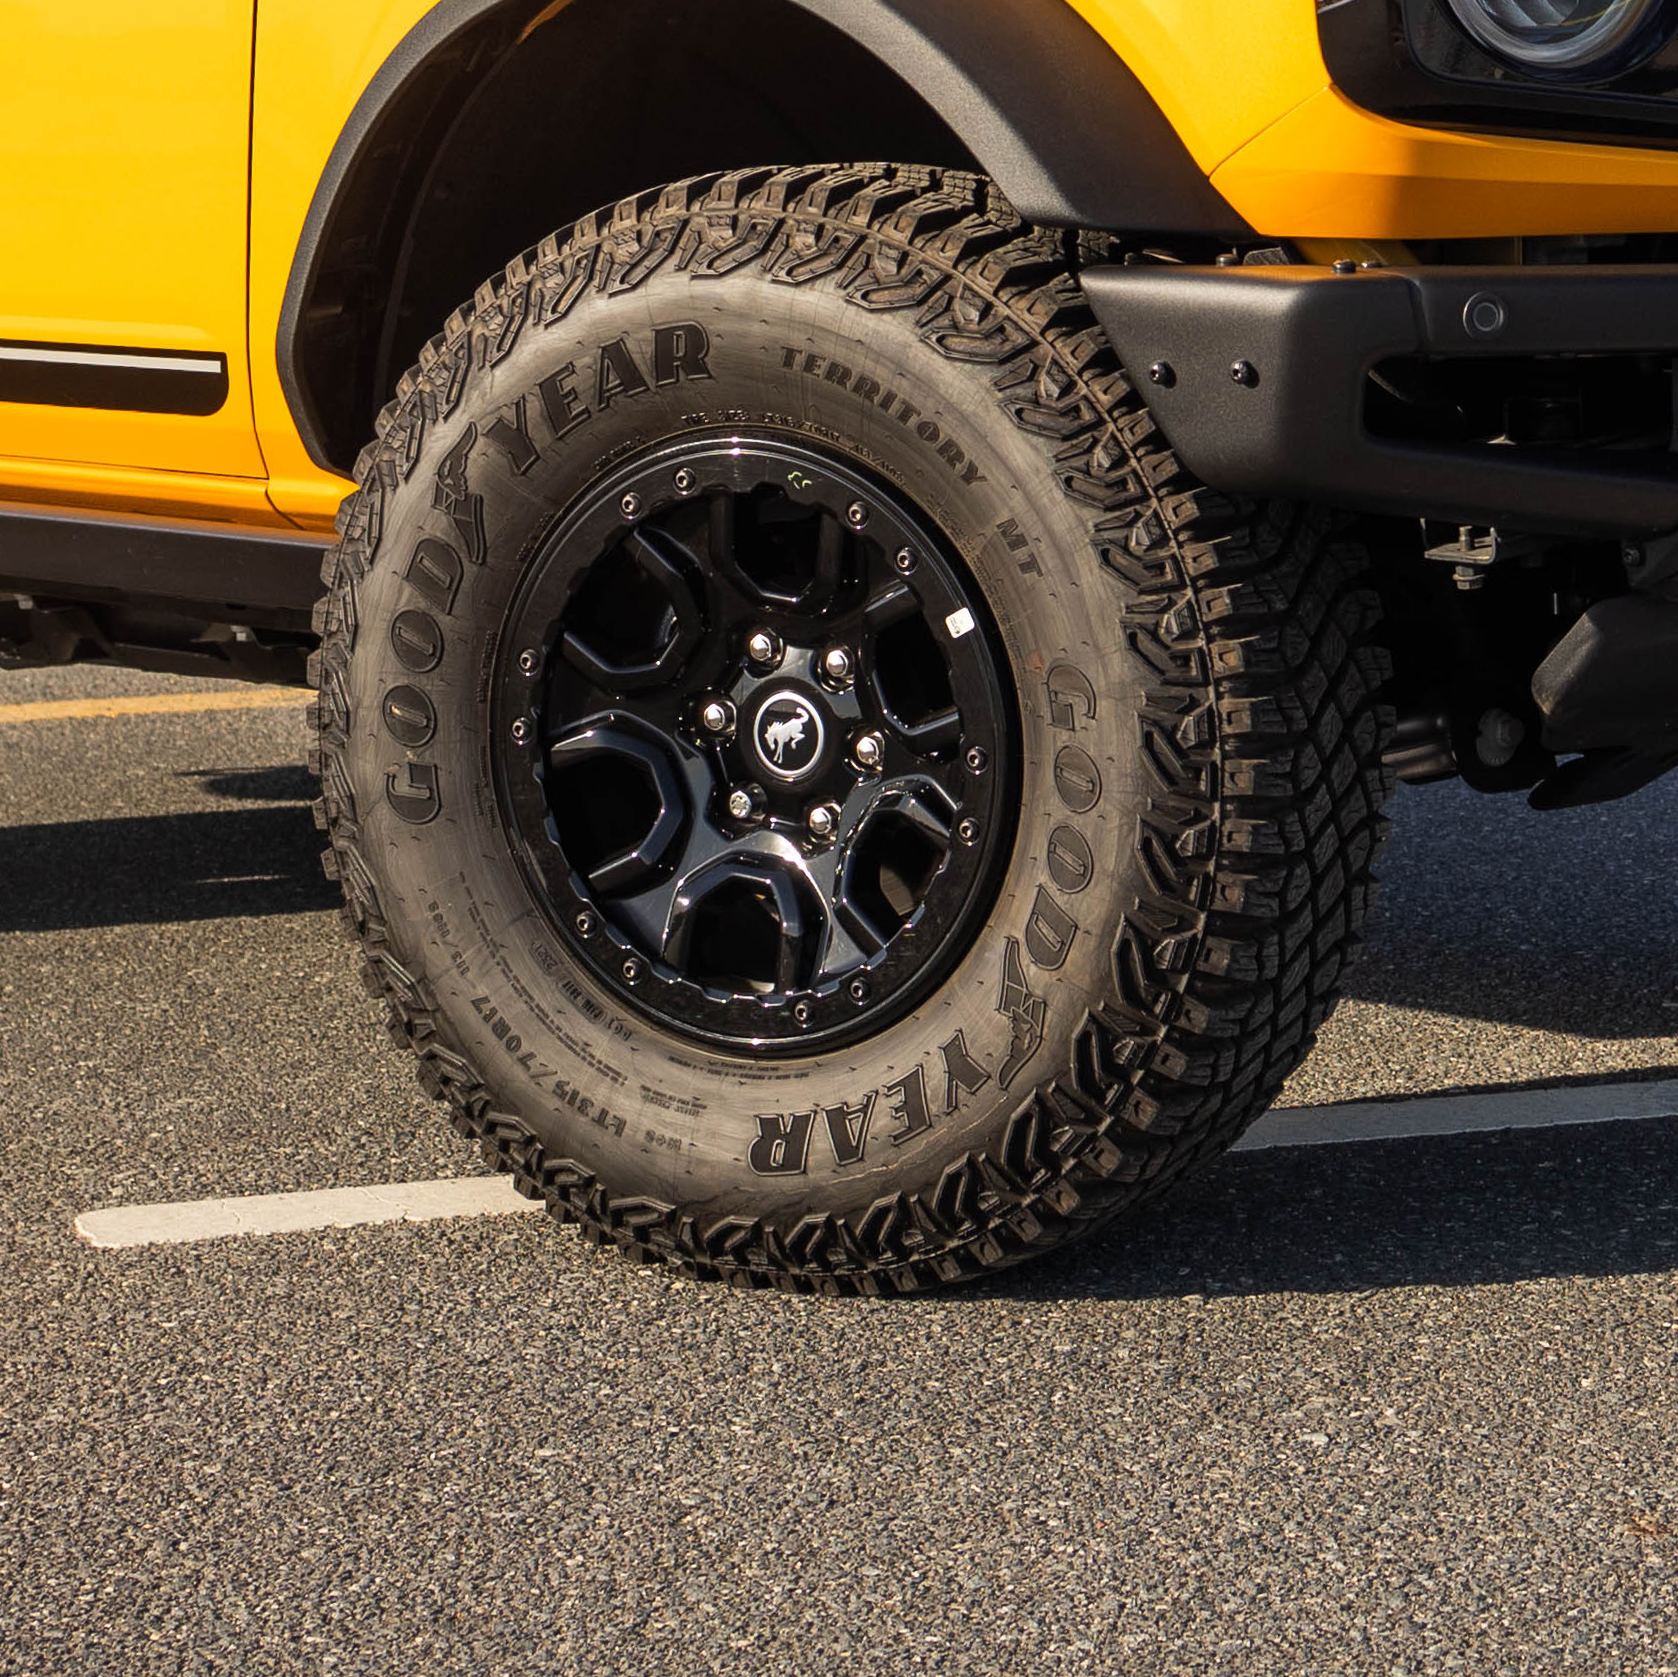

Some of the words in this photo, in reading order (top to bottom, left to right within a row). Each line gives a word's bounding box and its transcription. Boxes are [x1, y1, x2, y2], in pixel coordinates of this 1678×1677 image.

[782, 345, 988, 488] TERRITORY
[996, 517, 1044, 579] MT
[470, 994, 628, 1138] LT315/70R17
